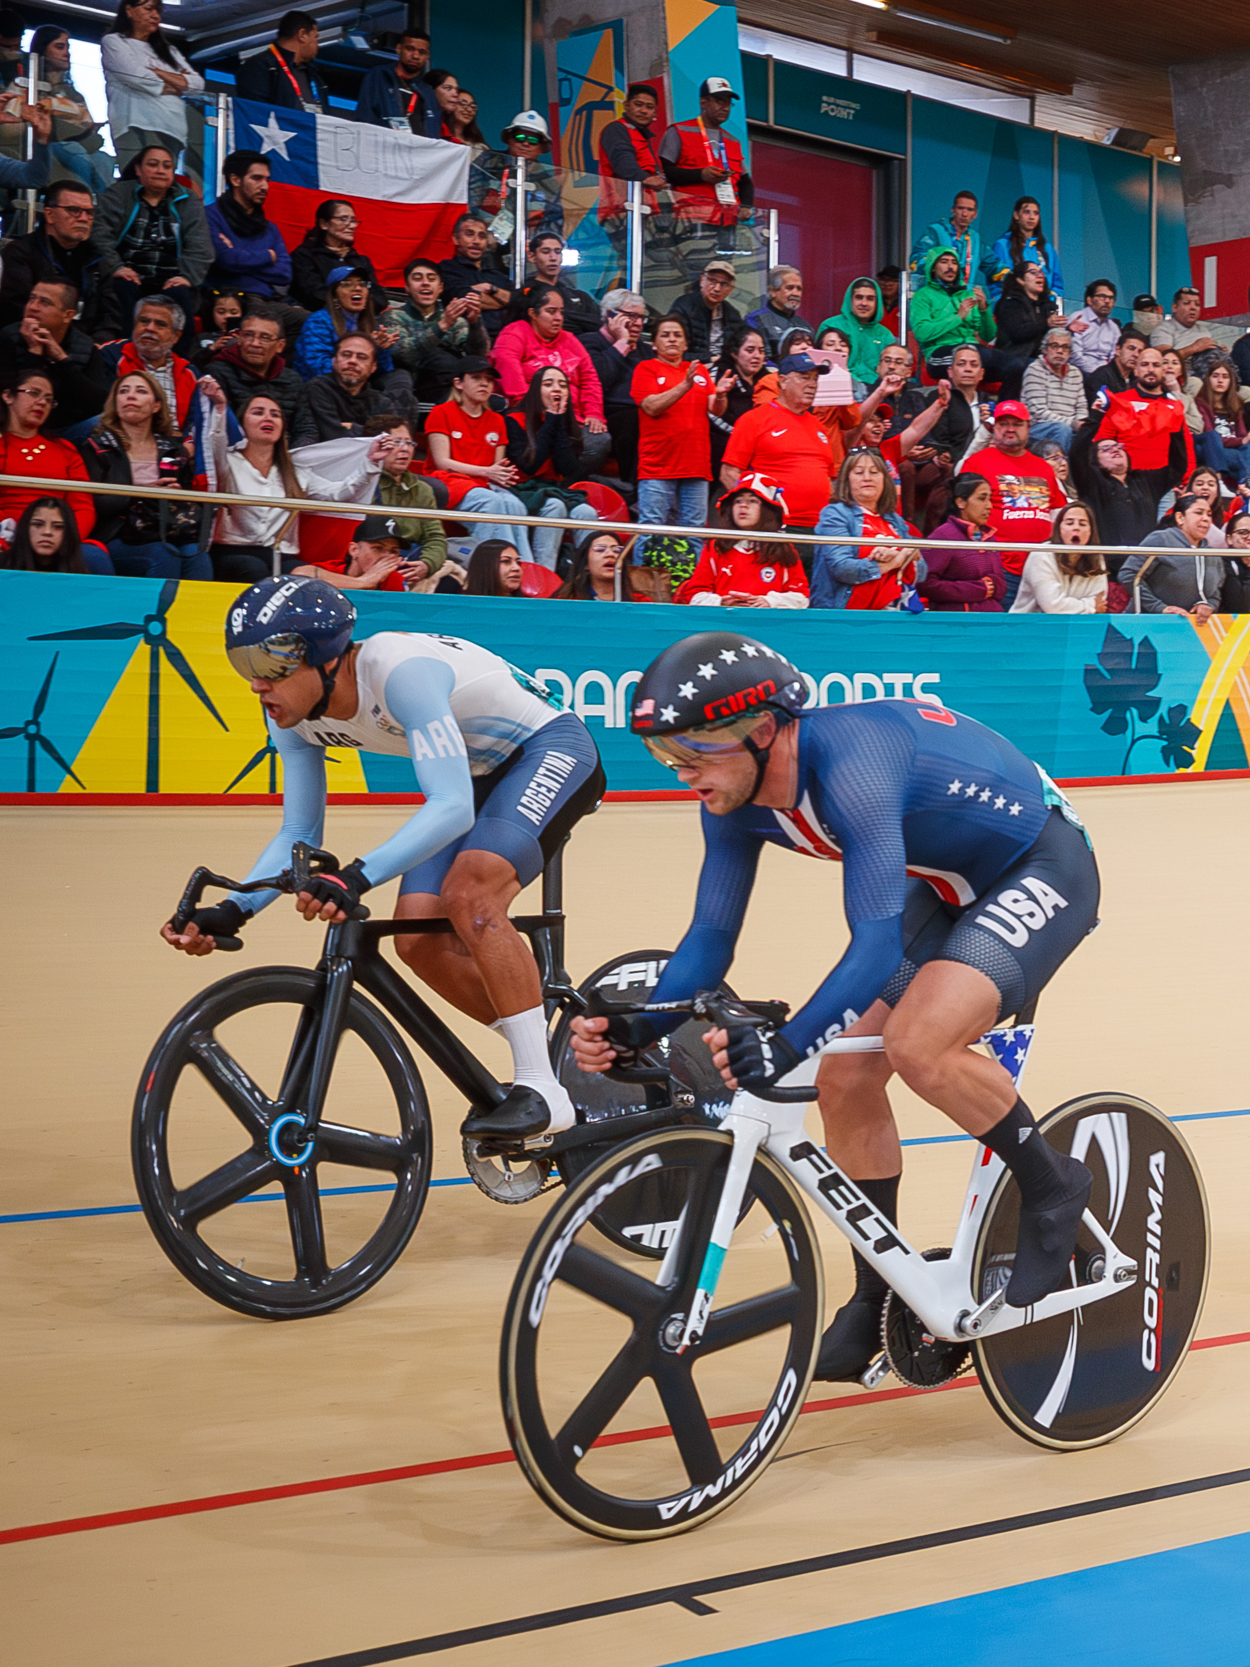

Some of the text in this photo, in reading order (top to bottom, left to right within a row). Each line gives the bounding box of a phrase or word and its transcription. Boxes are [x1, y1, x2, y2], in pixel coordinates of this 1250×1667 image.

[333, 126, 417, 180] BUIN
[703, 679, 777, 720] GIRO
[313, 731, 364, 748] ARG
[516, 750, 578, 827] ARGENTINA
[974, 876, 1070, 949] USA
[805, 1007, 862, 1058] USA
[789, 1141, 912, 1256] FELT
[527, 1152, 665, 1330] CORIMA
[1141, 1150, 1166, 1373] CORIMA
[656, 1366, 799, 1521] CORIMA
